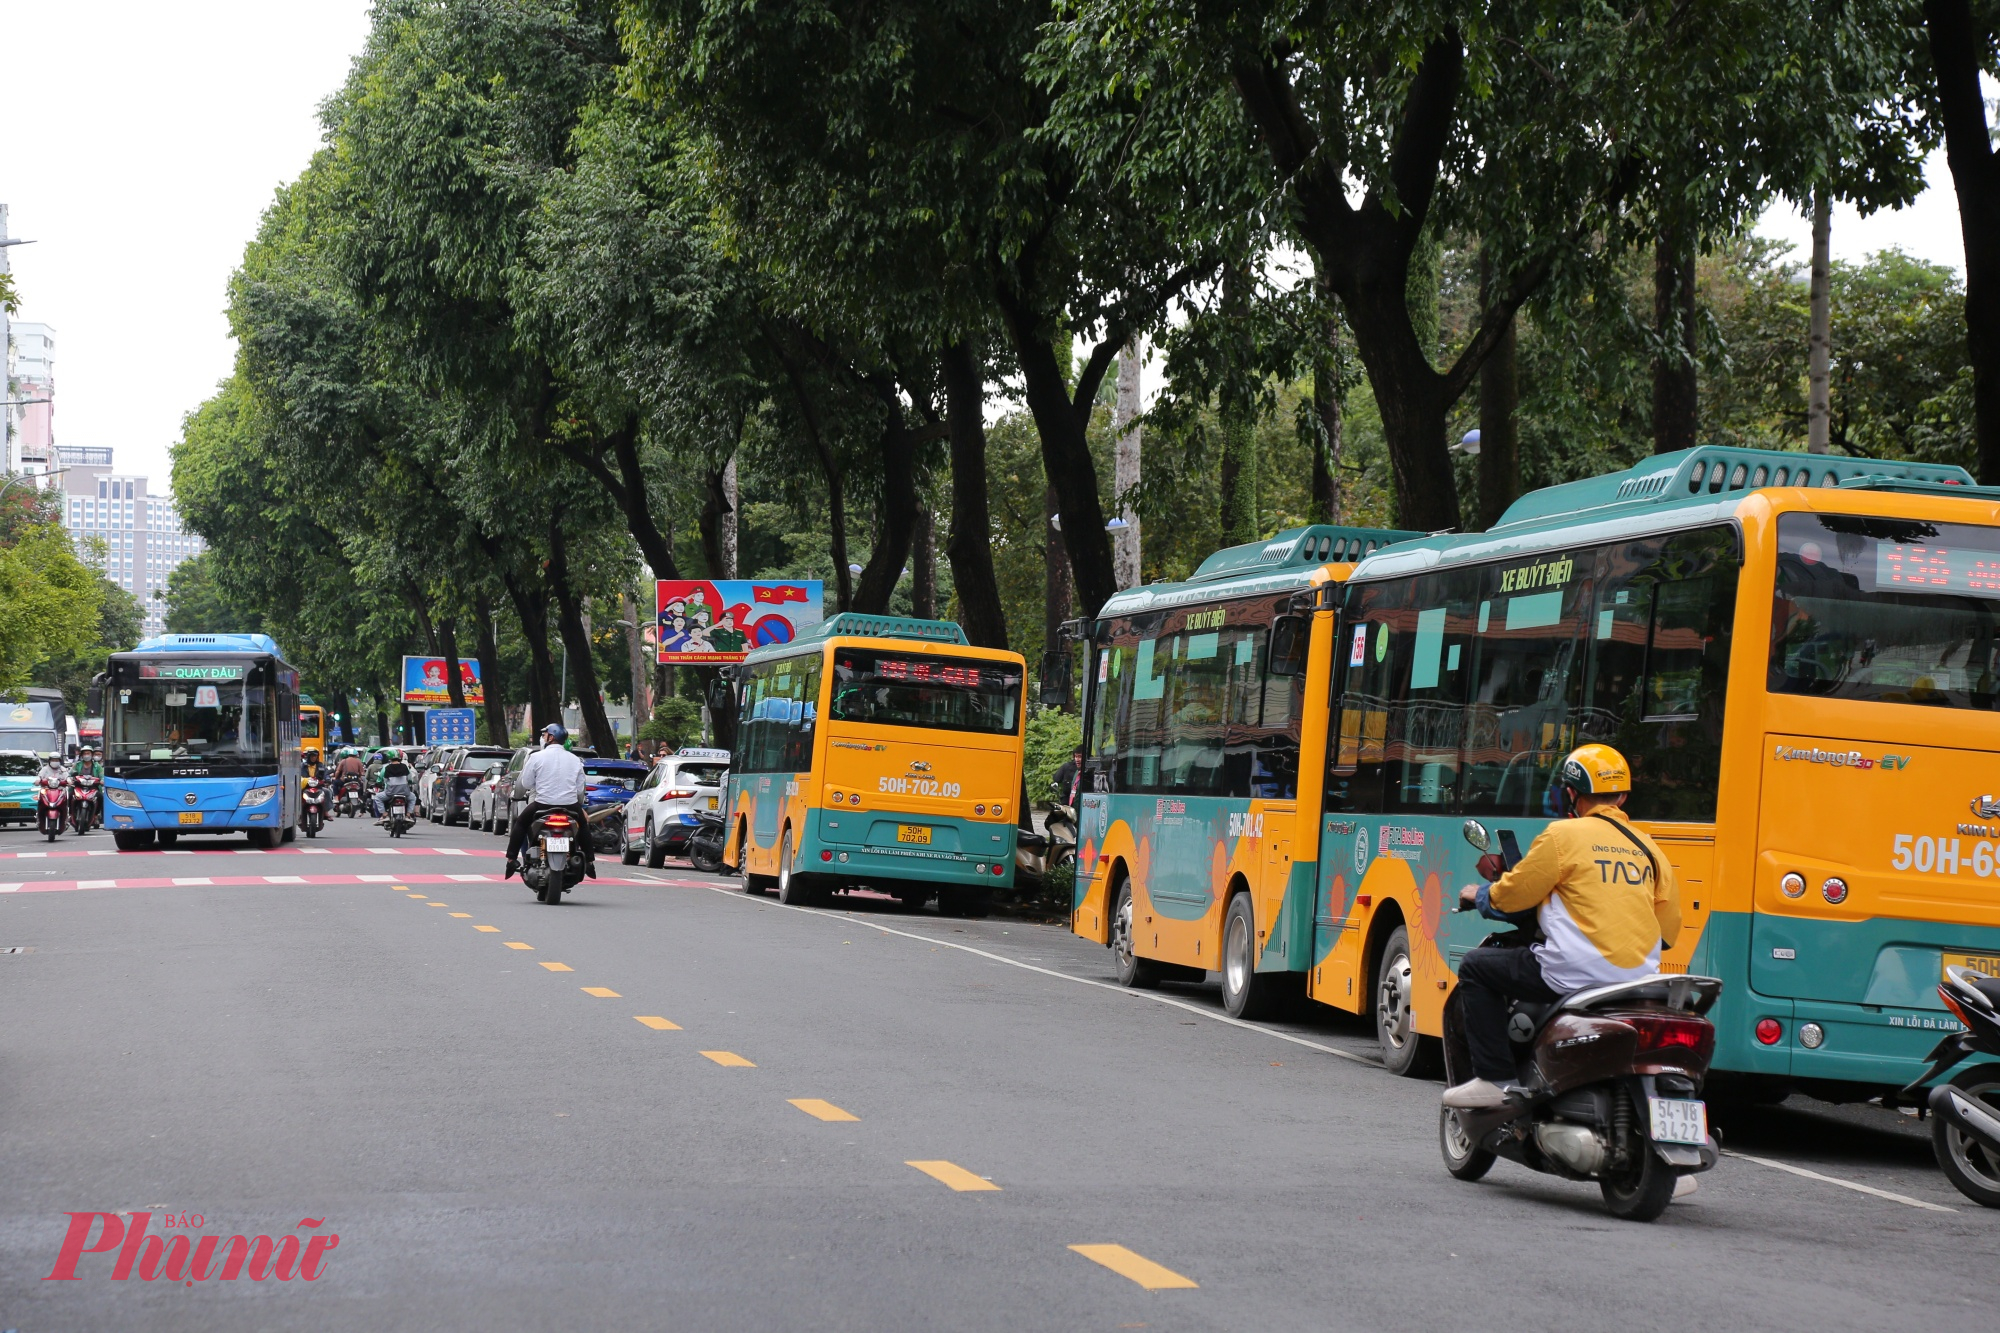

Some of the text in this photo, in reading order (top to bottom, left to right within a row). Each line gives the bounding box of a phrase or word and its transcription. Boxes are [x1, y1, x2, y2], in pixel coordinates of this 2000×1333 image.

[1499, 554, 1573, 593] XE BUÝT ĐIỆN
[1185, 614, 1196, 631] XE
[1194, 606, 1212, 630] BUÝT
[1353, 636, 1365, 660] 156
[175, 668, 209, 679] QUAY
[198, 689, 216, 705] 19
[172, 768, 209, 776] FOTON
[878, 776, 961, 798] 50H-702.09
[901, 833, 928, 843] 702.09
[907, 826, 923, 835] 50H
[1401, 826, 1412, 845] Bus
[1411, 827, 1425, 846] Lines
[1956, 823, 1988, 837] KIM
[870, 847, 880, 855] LỖI
[1591, 843, 1610, 853] ỨNG
[1891, 833, 2000, 879] 50H-6
[1888, 1016, 1904, 1026] XIN
[1906, 1014, 1921, 1028] LỖI
[1923, 1017, 1936, 1029] ĐÃ
[1940, 1018, 1958, 1031] LÀM
[1658, 1100, 1698, 1121] 54-V8
[1659, 1121, 1700, 1142] 3422
